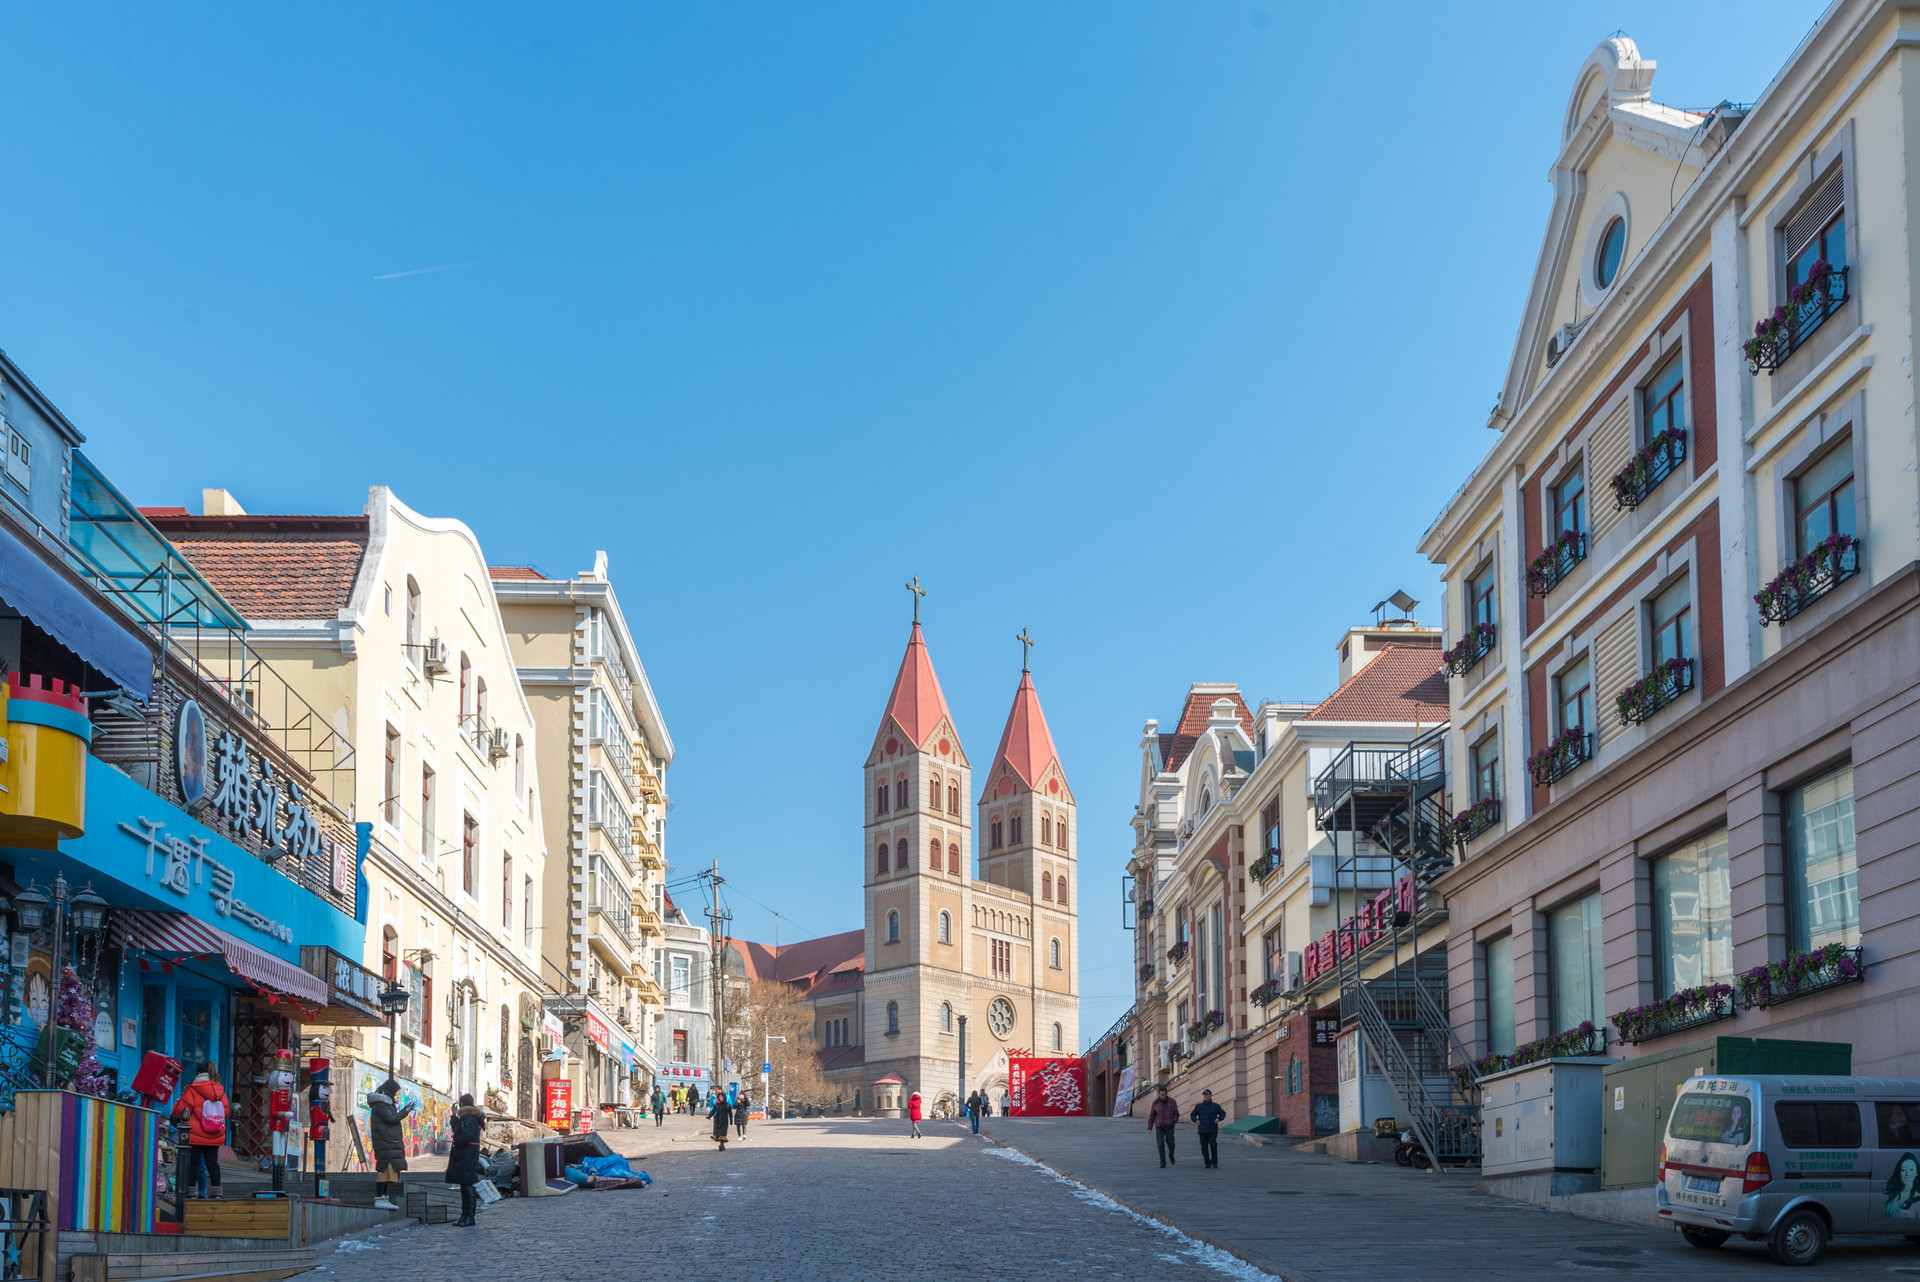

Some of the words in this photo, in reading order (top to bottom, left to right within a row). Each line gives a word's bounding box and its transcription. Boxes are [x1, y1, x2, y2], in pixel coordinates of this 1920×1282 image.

[551, 1088, 568, 1119] 干海货
[548, 1119, 569, 1128] 批发
